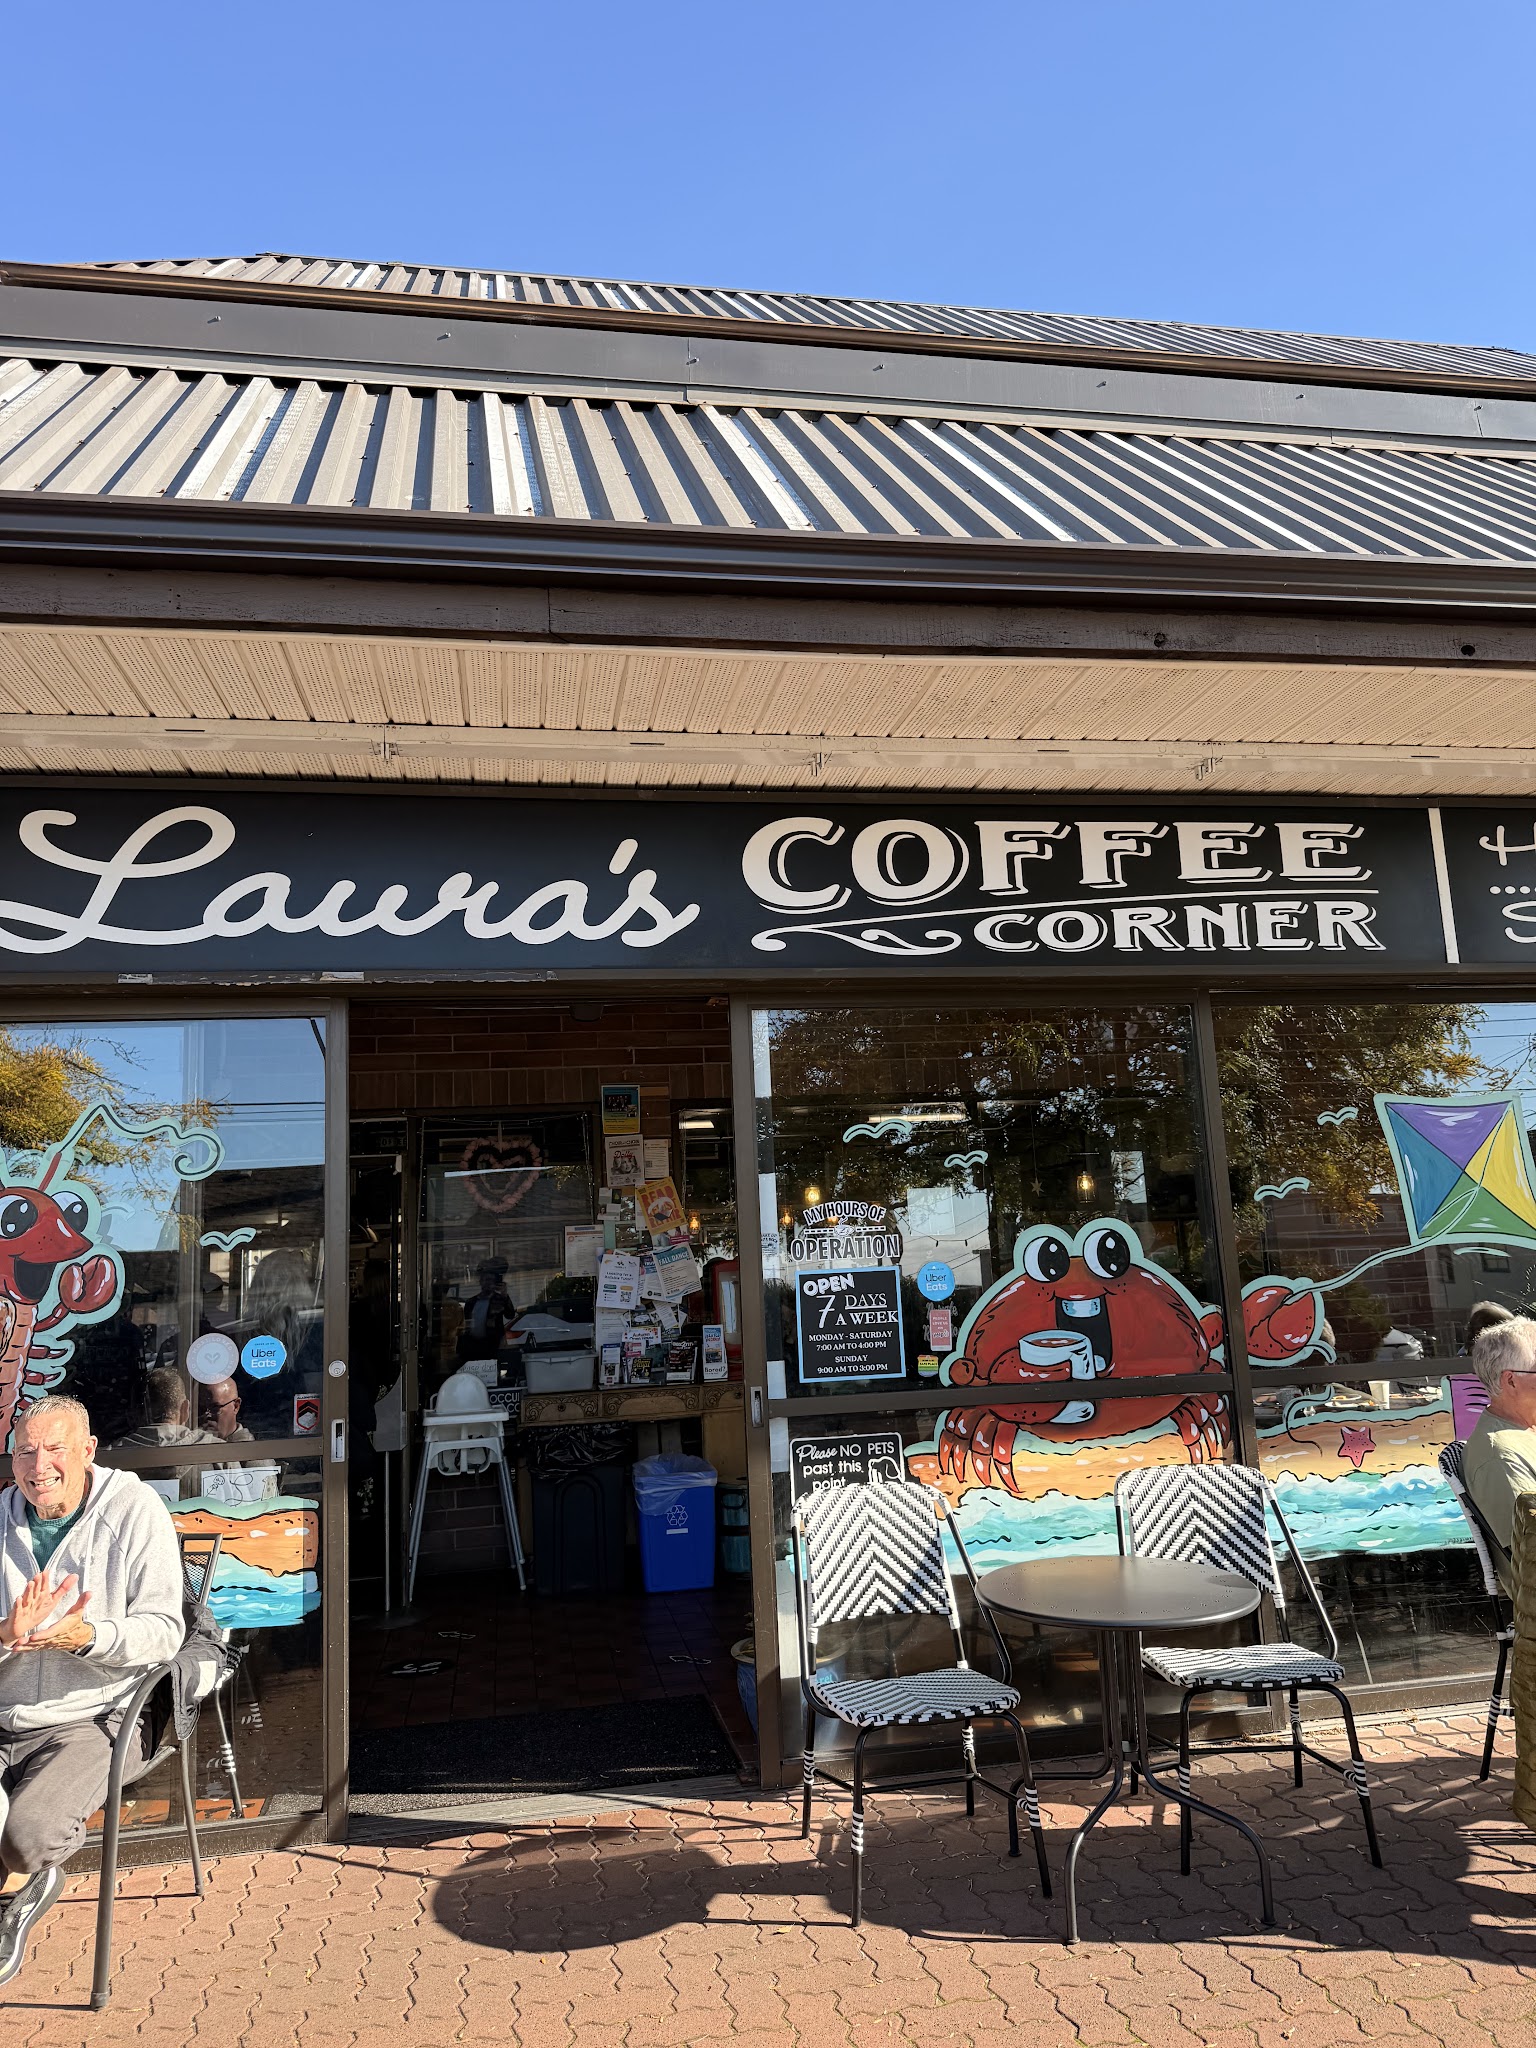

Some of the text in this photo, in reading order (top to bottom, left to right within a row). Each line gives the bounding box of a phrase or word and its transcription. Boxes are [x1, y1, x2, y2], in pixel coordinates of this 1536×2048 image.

[741, 816, 1373, 914] COFFEE
[0, 806, 700, 954] Laura's
[973, 901, 1386, 951] CORNER
[803, 1201, 886, 1225] MY HOURS OF
[791, 1234, 900, 1261] OPERATION
[658, 1256, 672, 1267] FALL
[671, 1251, 689, 1262] DANCE
[803, 1273, 855, 1296] OPEN
[925, 1273, 947, 1282] Uber
[926, 1282, 948, 1292] Eats
[816, 1293, 887, 1328] 7 DAYS
[835, 1311, 899, 1326] A WEEK
[808, 1333, 844, 1342] MONDAY
[849, 1330, 893, 1340] SATURDAY
[251, 1349, 276, 1358] Uber
[816, 1343, 832, 1351] 7:00
[846, 1342, 856, 1350] TO
[857, 1341, 874, 1349] 4:00
[251, 1359, 277, 1368] Eats
[834, 1354, 868, 1363] SUNDAY
[704, 1365, 726, 1373] Bored?
[817, 1366, 833, 1374] 9:00
[847, 1365, 858, 1373] TO
[859, 1364, 875, 1372] 3:00
[796, 1441, 895, 1463] Please NO PETS
